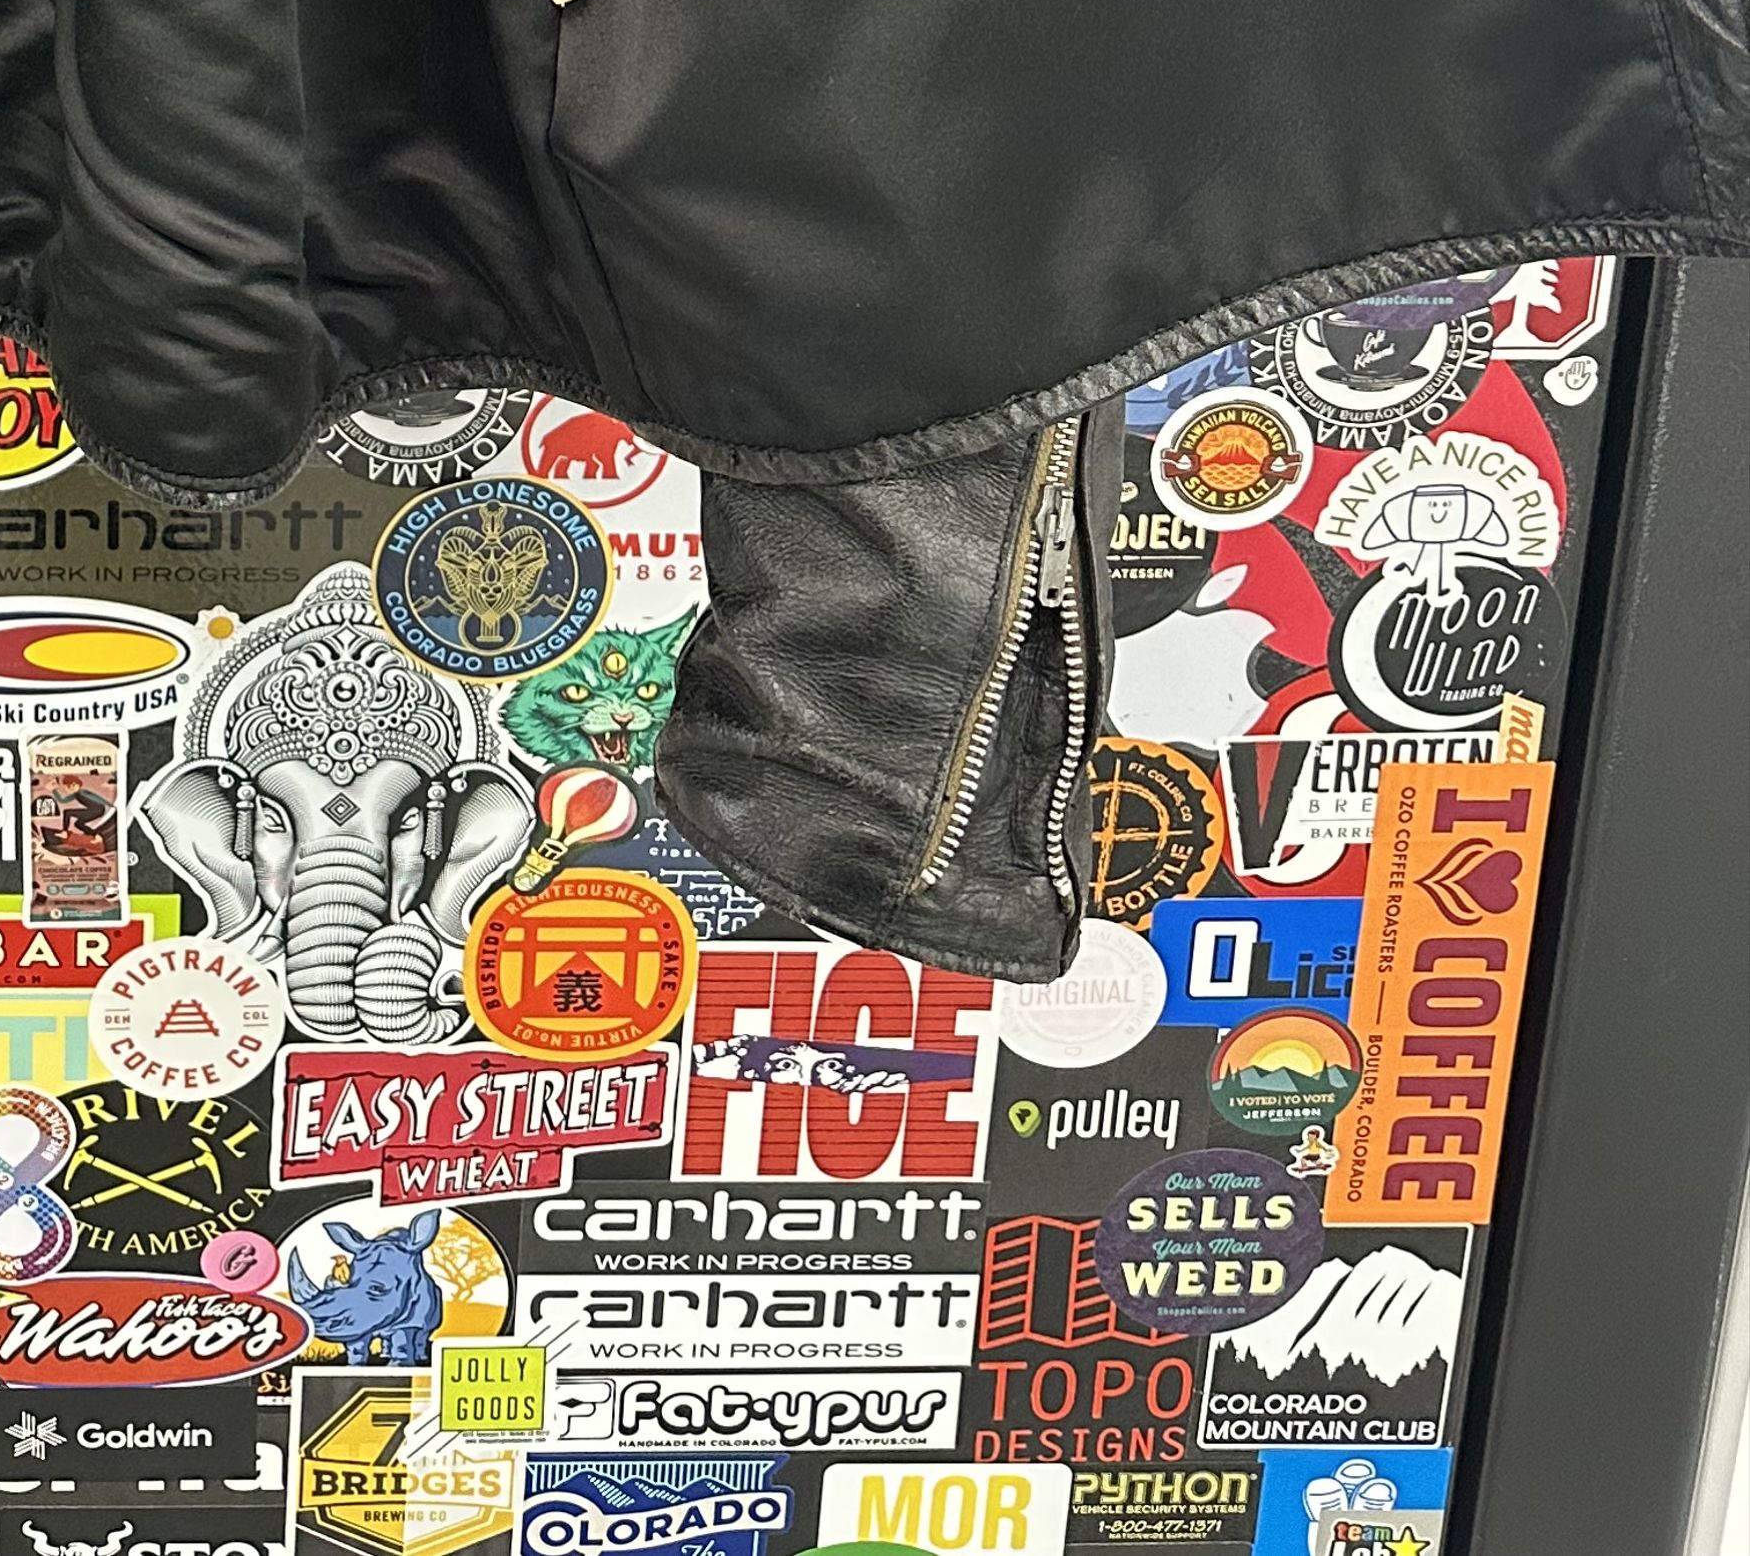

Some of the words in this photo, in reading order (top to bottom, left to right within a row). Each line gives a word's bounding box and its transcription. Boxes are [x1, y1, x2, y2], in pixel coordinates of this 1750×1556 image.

[1183, 409, 1236, 451] HAWAIIAN
[1240, 409, 1286, 452] VOLCANO
[1185, 478, 1220, 505] SEA
[1223, 480, 1269, 507] SALT
[1326, 456, 1399, 539] HAVE
[1408, 445, 1431, 467] A
[1442, 442, 1526, 490] NICE
[1514, 491, 1547, 556] RUN
[390, 498, 447, 556] HIGH
[455, 482, 596, 552] LONESOME
[95, 567, 125, 582] IN
[132, 566, 300, 583] PROGRESS
[385, 589, 483, 672] COLORADO
[493, 586, 599, 672] BLUEGRASS
[34, 700, 126, 726] Country
[134, 686, 179, 713] USA
[36, 755, 112, 767] REGRAINED
[1398, 786, 1417, 824] OZO
[1432, 788, 1532, 834] I
[1389, 829, 1411, 890] COFFEE
[1106, 843, 1193, 917] BOTTLE
[1378, 894, 1402, 974] ROASTERS
[114, 949, 261, 999] PIGTRAIN
[478, 921, 504, 1010] BUSHIDO
[661, 941, 681, 992] SAKE
[553, 970, 604, 1013] 義
[570, 1024, 642, 1049] VIRTUE
[109, 1037, 222, 1088] COFFEE
[227, 1031, 264, 1070] CO
[1357, 1034, 1382, 1111] BOULDER,
[1381, 937, 1509, 1201] COFFEE
[288, 1074, 445, 1159] EASY
[454, 1062, 661, 1138] STREET
[1237, 1096, 1277, 1106] VOTED
[1284, 1095, 1301, 1105] YO
[1243, 1108, 1321, 1120] JEFFERSON
[1047, 1091, 1180, 1150] pulley
[398, 1152, 538, 1193] WHEAT
[1347, 1115, 1372, 1203] COLORADO
[1165, 1172, 1204, 1191] Our
[1208, 1173, 1263, 1192] Mom
[122, 1187, 272, 1256] AMERICA
[534, 1190, 981, 1241] carhartt
[1127, 1195, 1296, 1232] SELLS
[594, 1255, 689, 1270] WORK
[699, 1255, 726, 1269] IN
[735, 1255, 912, 1271] PROGRESS
[1153, 1239, 1203, 1260] Your
[1208, 1238, 1263, 1258] Mom
[1121, 1259, 1286, 1297] WEED
[156, 1294, 200, 1317] Fish
[451, 1357, 527, 1382] JOLLY
[590, 1343, 686, 1358] WORK
[693, 1343, 721, 1358] IN
[731, 1343, 903, 1358] PROGRESS
[457, 1396, 535, 1420] GOODS
[978, 1358, 1193, 1422] TOPO
[1209, 1393, 1368, 1415] COLORADO
[77, 1422, 212, 1450] Goldwin
[975, 1427, 1186, 1463] DESIGNS
[1206, 1420, 1353, 1441] MOUNTAIN
[1363, 1420, 1436, 1441] CLUB
[312, 1469, 501, 1497] BRIDGES
[1072, 1472, 1249, 1505] PYTHON
[364, 1511, 425, 1522] BREWING
[430, 1511, 446, 1522] CO
[1072, 1504, 1123, 1514] VEHICLE
[1126, 1504, 1186, 1514] SECURITY
[1189, 1504, 1246, 1514] SYSTEMS
[1098, 1519, 1222, 1534] 1-800-477-1371
[1333, 1521, 1393, 1543] team
